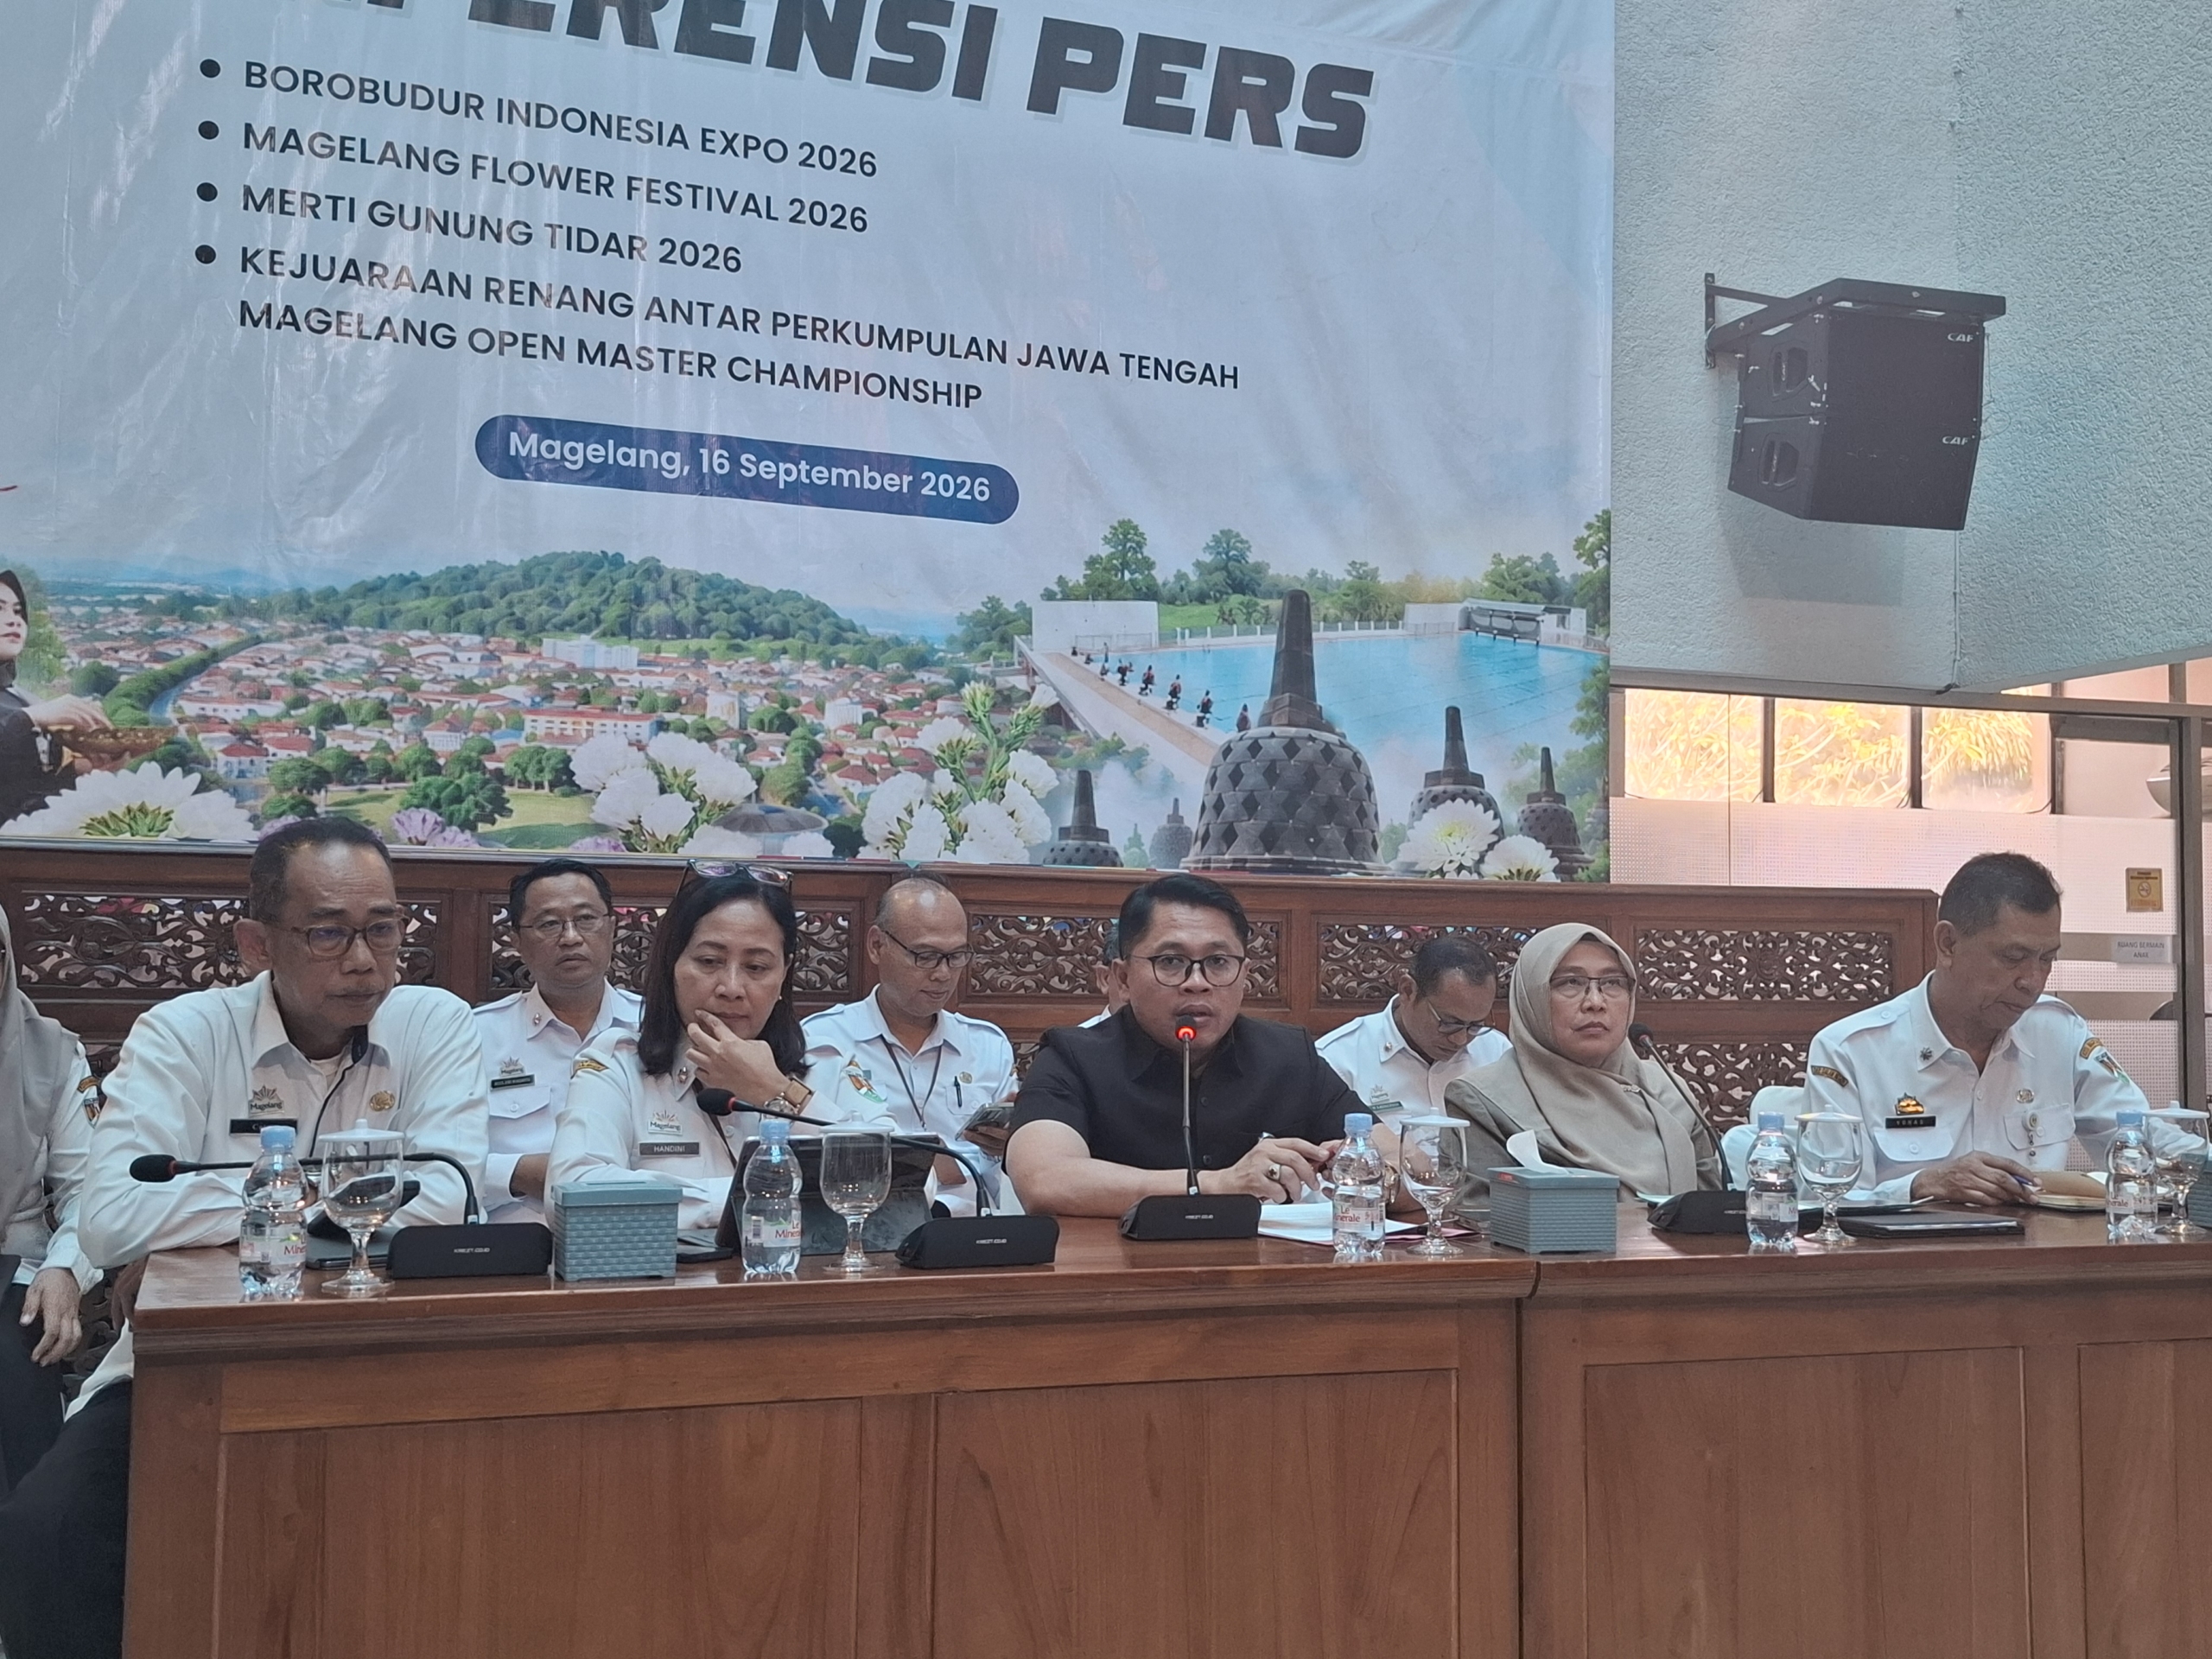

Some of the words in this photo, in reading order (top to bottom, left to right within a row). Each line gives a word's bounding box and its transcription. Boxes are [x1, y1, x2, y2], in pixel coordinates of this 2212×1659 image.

[245, 60, 485, 121] BOROBUDUR
[497, 98, 690, 150] INDONESIA
[701, 127, 789, 163] EXPO
[798, 141, 877, 177] 2026
[1027, 16, 1374, 159] PERS
[244, 122, 460, 175] MAGELANG
[472, 154, 614, 199] FLOWER
[626, 175, 779, 221] FESTIVAL
[788, 198, 868, 233] 2026
[243, 184, 355, 223] MERTI
[367, 200, 533, 246] GUNUNG
[544, 222, 647, 262] TIDAR
[658, 238, 741, 273] 2026
[240, 300, 457, 350] MAGELANG
[467, 327, 565, 361] OPEN
[577, 338, 717, 378] MASTER
[728, 356, 982, 409] CHAMPIONSHIP
[241, 246, 472, 300] KEJUARAAN
[485, 276, 634, 318] RENANG
[644, 296, 760, 334] ANTAR
[772, 311, 1007, 365] PERKUMPULAN
[1016, 342, 1110, 375] JAWA
[1119, 353, 1239, 390] TENGAH
[1947, 332, 1974, 343] CAF
[510, 432, 690, 480] Magelang,
[699, 448, 730, 475] 16
[740, 453, 913, 493] September
[920, 471, 990, 501] 2026
[1942, 435, 1968, 446] CAF
[250, 1102, 283, 1111] Magelang
[1340, 1205, 1350, 1215] Le
